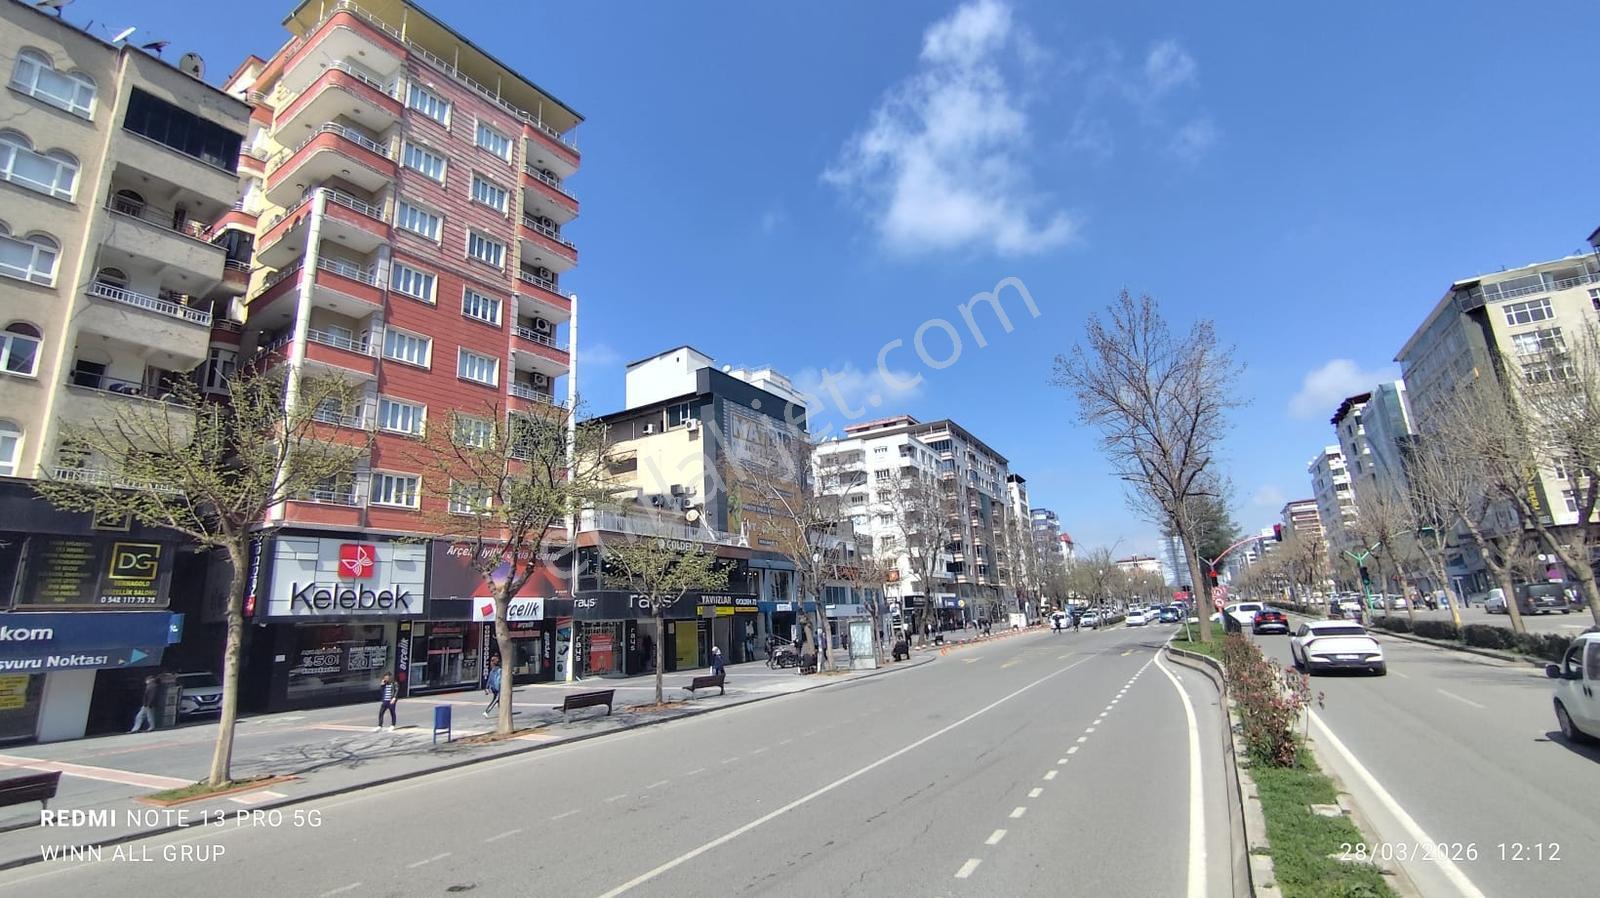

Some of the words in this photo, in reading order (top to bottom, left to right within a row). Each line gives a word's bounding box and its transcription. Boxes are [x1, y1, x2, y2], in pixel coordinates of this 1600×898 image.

[446, 545, 479, 559] Arçel
[666, 540, 694, 552] GOLDE
[118, 552, 155, 570] DG
[100, 596, 107, 604] 0
[291, 582, 411, 610] Kelebek
[509, 602, 539, 620] çelik
[573, 598, 595, 610] rays
[46, 655, 108, 667] Noktası
[399, 638, 409, 670] arçelik
